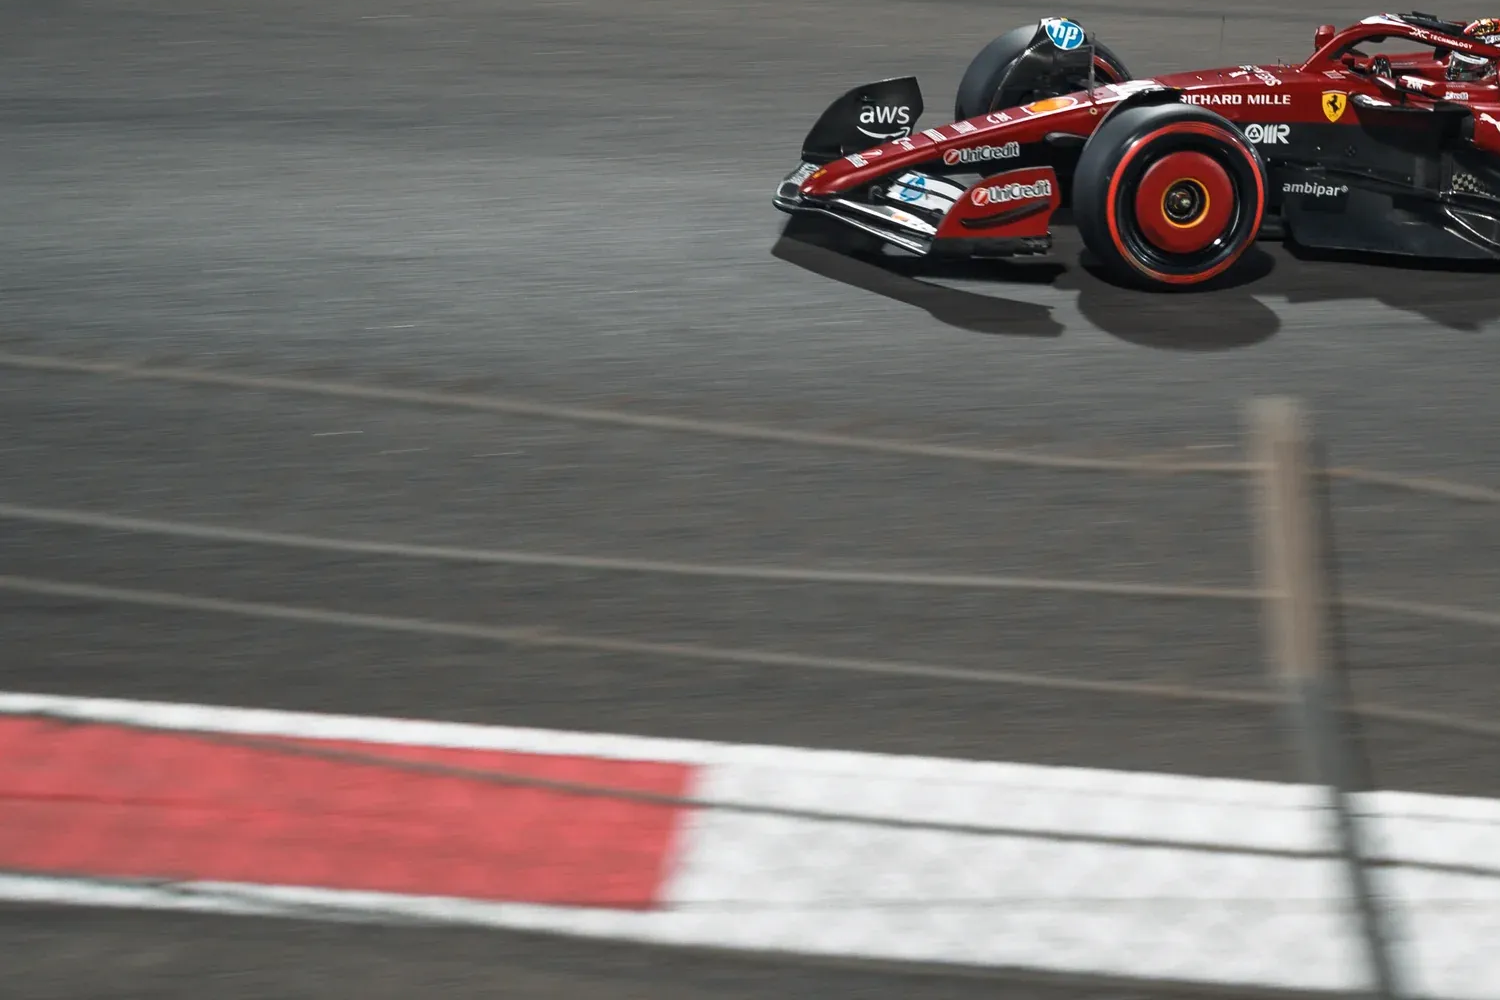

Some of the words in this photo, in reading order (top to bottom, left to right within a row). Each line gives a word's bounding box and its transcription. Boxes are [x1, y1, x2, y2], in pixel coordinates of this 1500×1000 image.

[1051, 21, 1079, 48] hp
[1430, 34, 1473, 49] TECHNOLOGY
[1247, 94, 1292, 105] MILLE
[859, 105, 910, 124] aws
[959, 142, 1020, 164] UniCredit
[988, 180, 1052, 204] UniCredit
